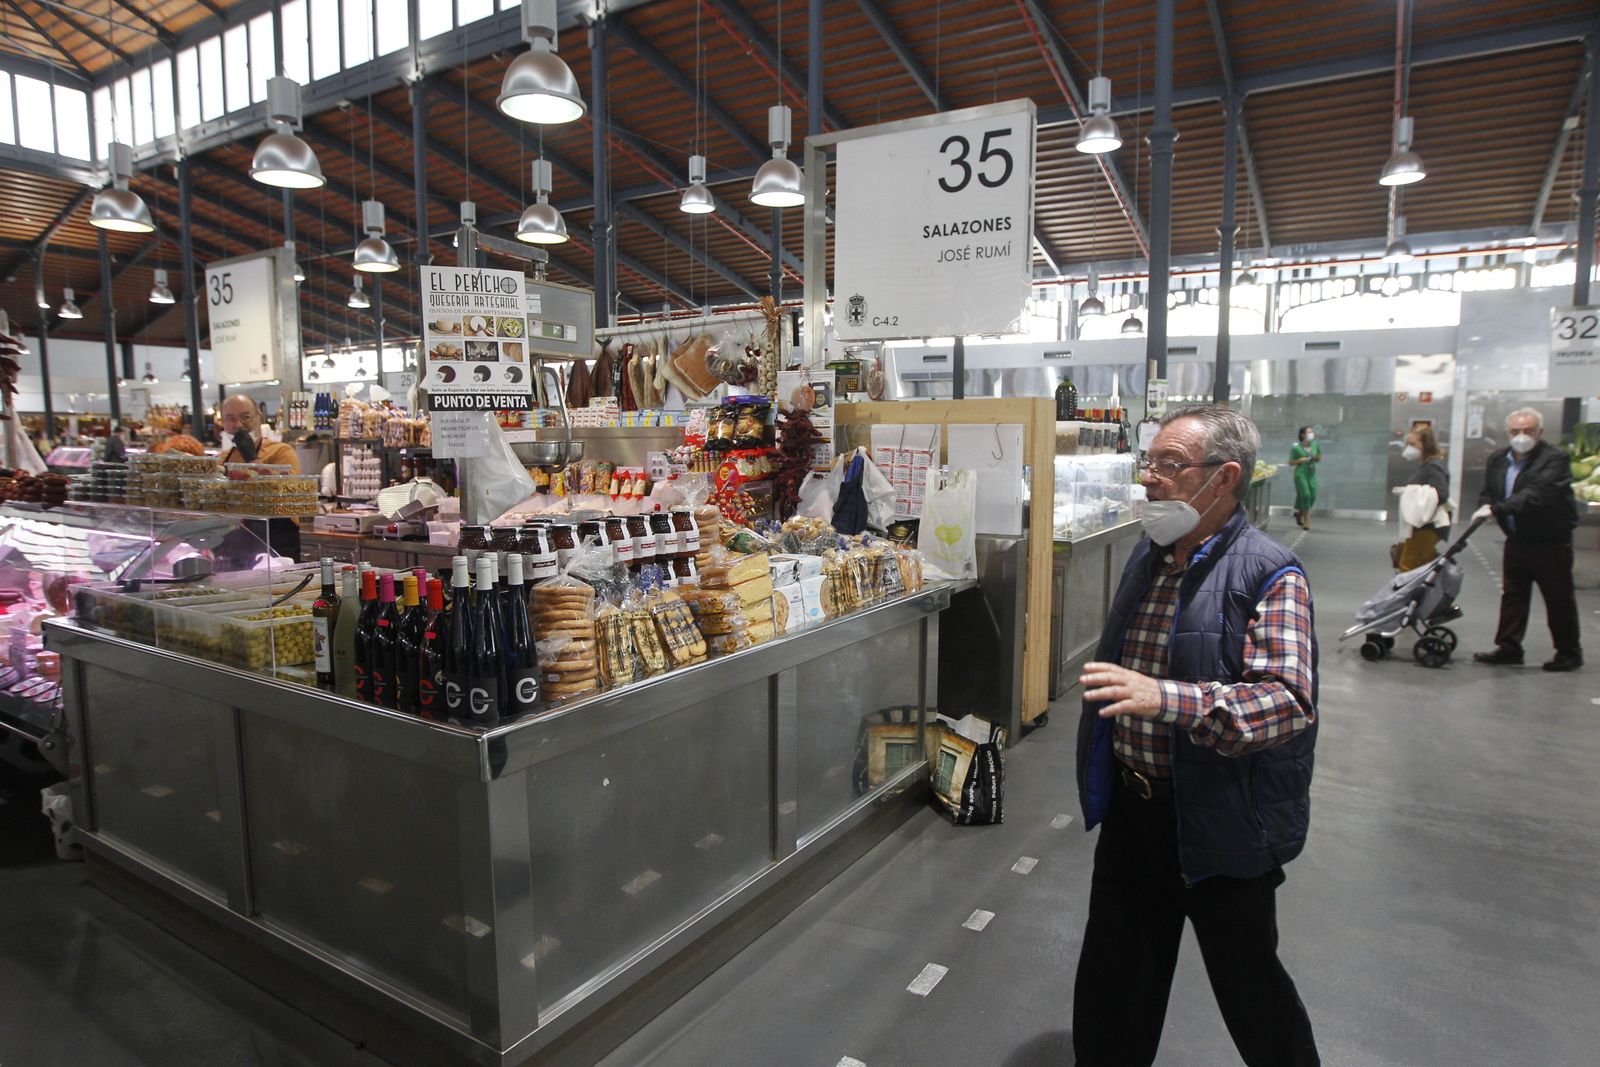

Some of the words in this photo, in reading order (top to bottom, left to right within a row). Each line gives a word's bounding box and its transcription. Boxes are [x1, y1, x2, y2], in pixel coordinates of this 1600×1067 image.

[938, 127, 1014, 194] 35
[922, 216, 1012, 239] SALAZONES
[937, 244, 971, 263] JOSÉ
[975, 240, 1012, 260] RUMÍ
[210, 272, 233, 306] 35
[430, 272, 446, 291] EL
[474, 295, 520, 309] ARTESANAL
[872, 315, 899, 327] C-4.2
[1558, 315, 1598, 340] 32
[401, 374, 412, 387] 25
[434, 395, 474, 408] PUNTO
[476, 395, 491, 408] DE
[492, 395, 528, 408] VENTA
